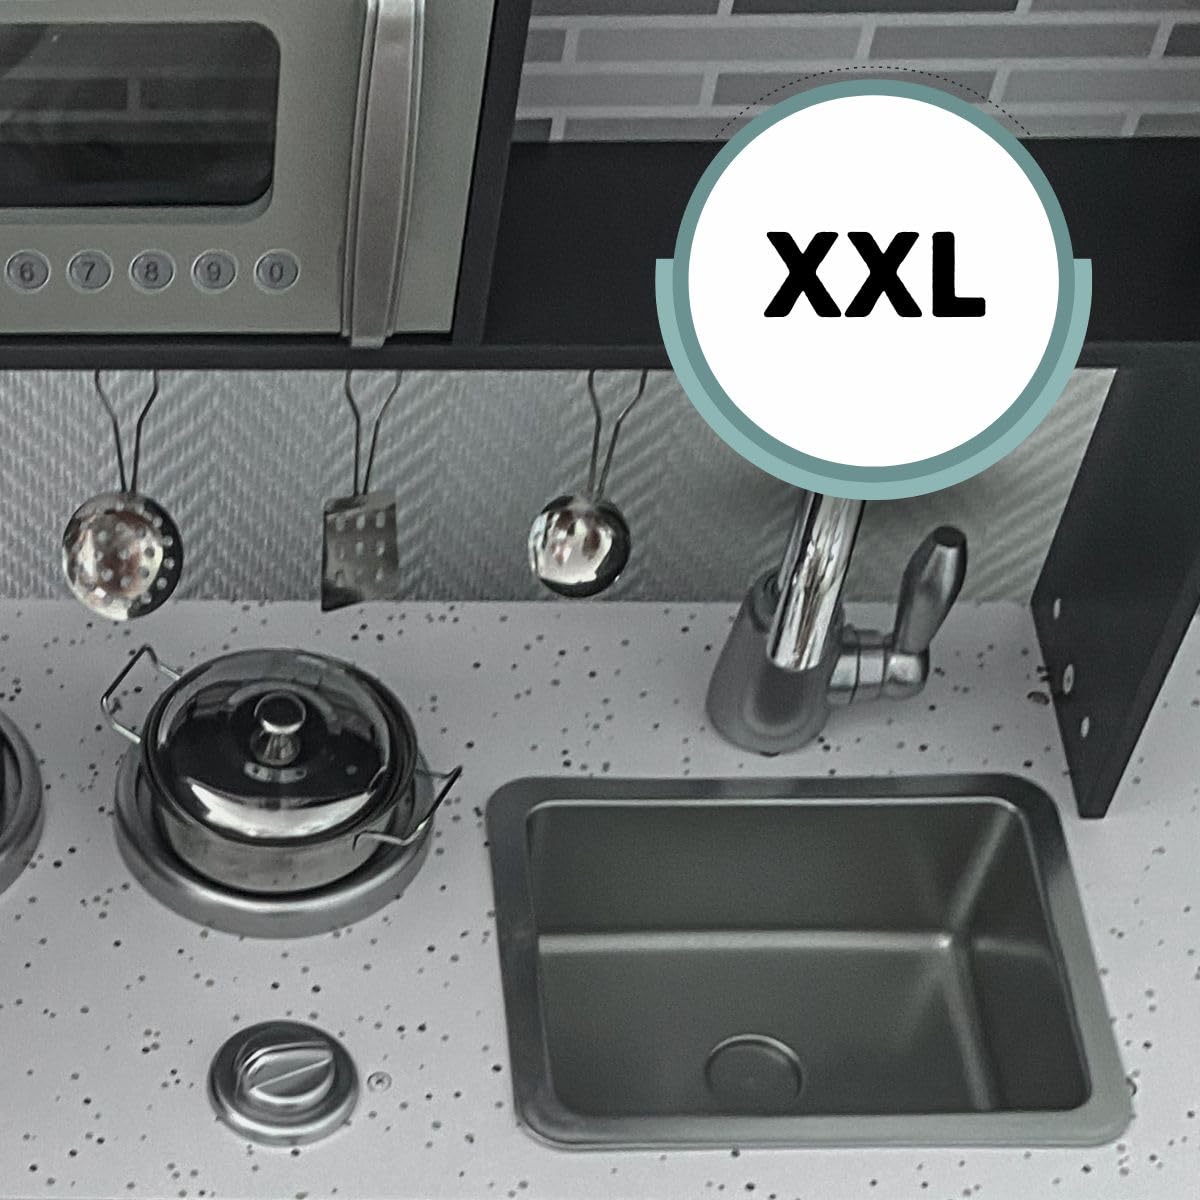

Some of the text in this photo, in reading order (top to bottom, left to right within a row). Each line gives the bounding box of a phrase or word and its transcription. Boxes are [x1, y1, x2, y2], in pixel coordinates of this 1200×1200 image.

[19, 262, 34, 282] 6
[82, 261, 96, 282] 7
[145, 261, 159, 282] 8
[206, 261, 221, 282] 9
[269, 262, 284, 283] 0
